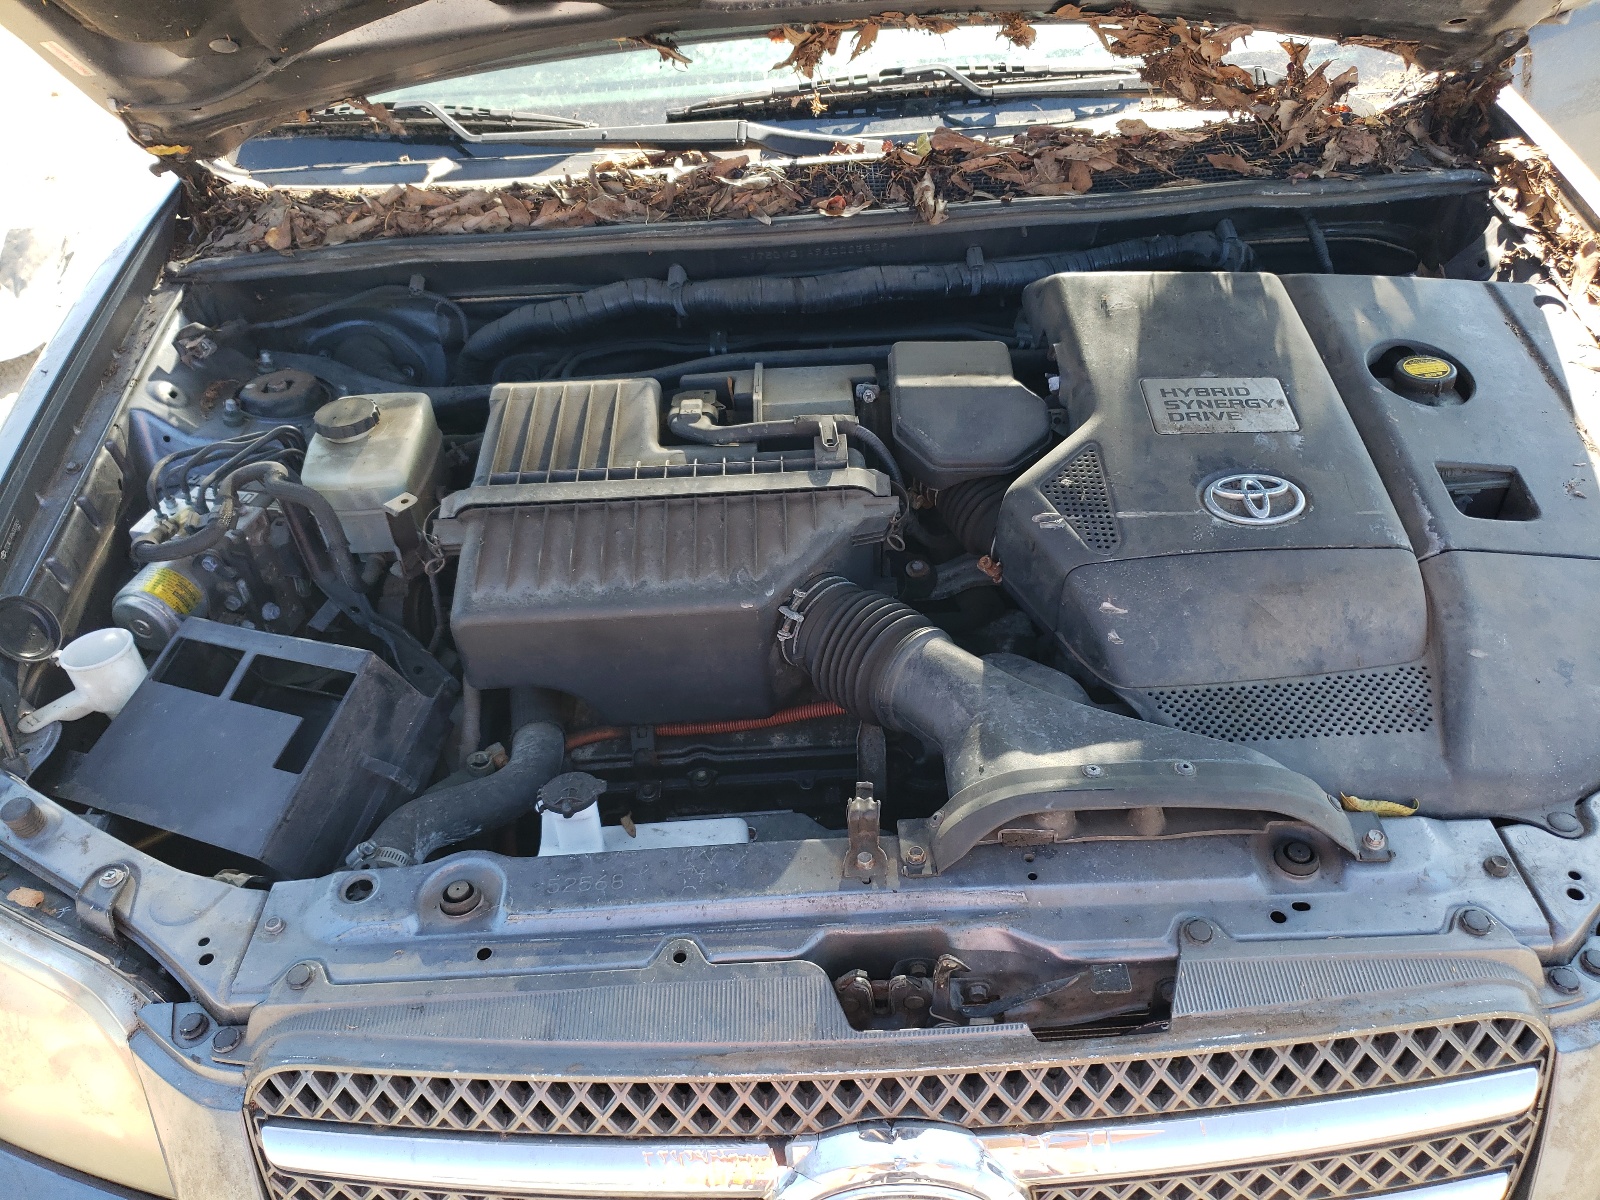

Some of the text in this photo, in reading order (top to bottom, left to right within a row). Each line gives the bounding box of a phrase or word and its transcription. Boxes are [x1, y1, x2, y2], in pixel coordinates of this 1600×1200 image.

[1159, 386, 1251, 398] HYBRID
[1163, 398, 1275, 410] SYNERGY
[1167, 411, 1243, 422] DRIVE
[546, 873, 624, 894] 52568
